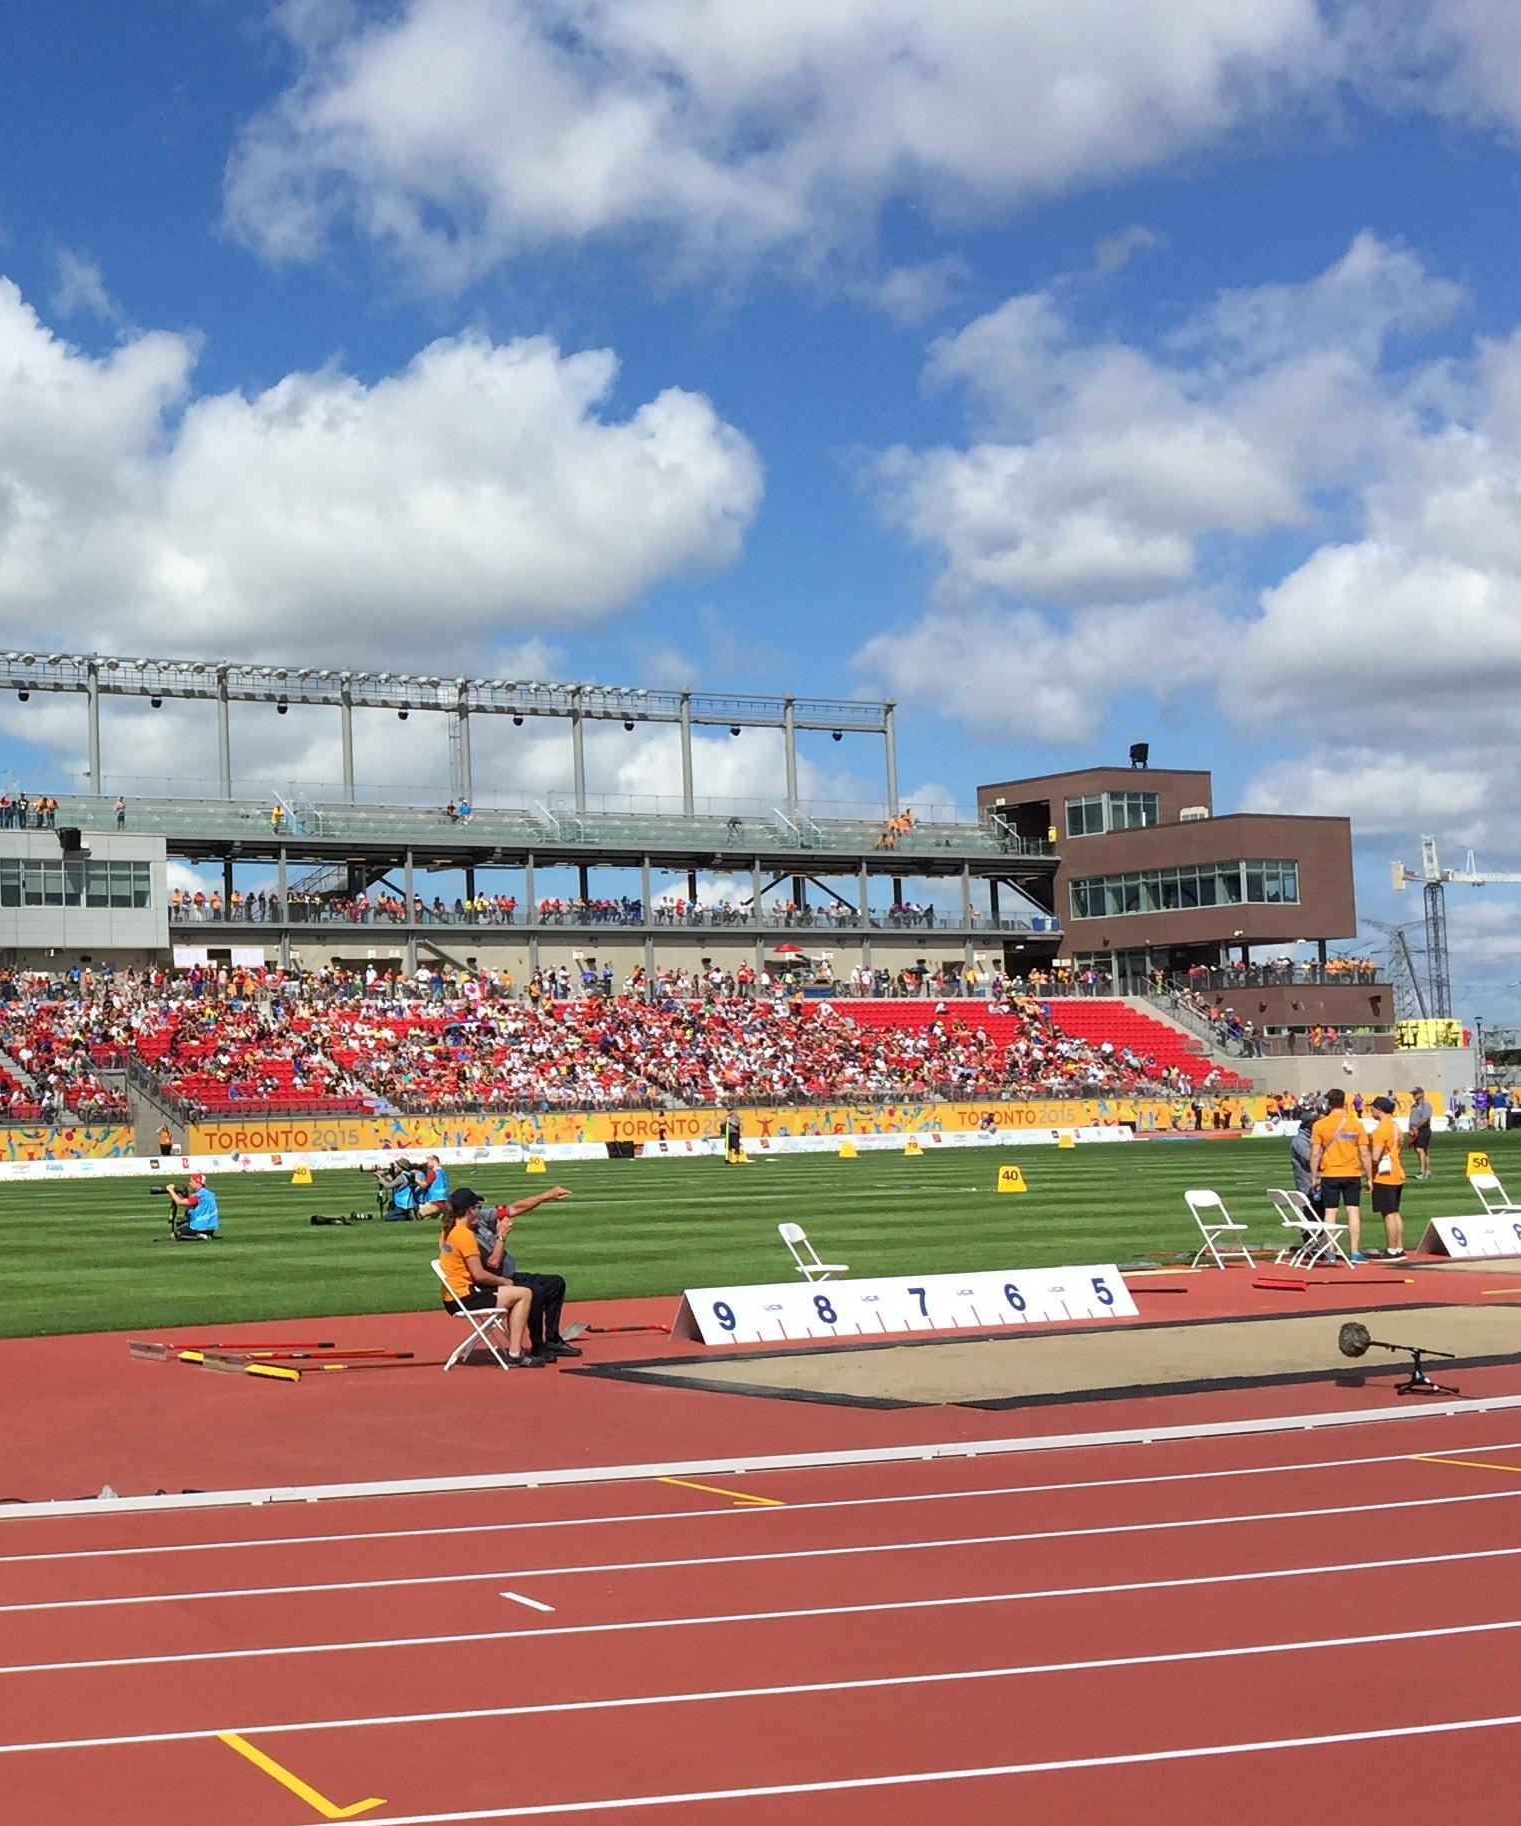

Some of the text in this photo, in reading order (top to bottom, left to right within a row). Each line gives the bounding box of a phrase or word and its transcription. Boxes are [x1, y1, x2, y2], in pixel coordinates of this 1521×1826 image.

[1038, 1108, 1076, 1124] 2015
[204, 1128, 360, 1150] TORONTO 2015
[1472, 1157, 1489, 1168] 50
[1001, 1170, 1019, 1181] 40
[1450, 1226, 1468, 1247] 9
[712, 1301, 737, 1331] 9
[813, 1294, 838, 1324] 8
[907, 1287, 929, 1317] 7
[1004, 1283, 1027, 1312] 6
[1090, 1277, 1114, 1306] 5
